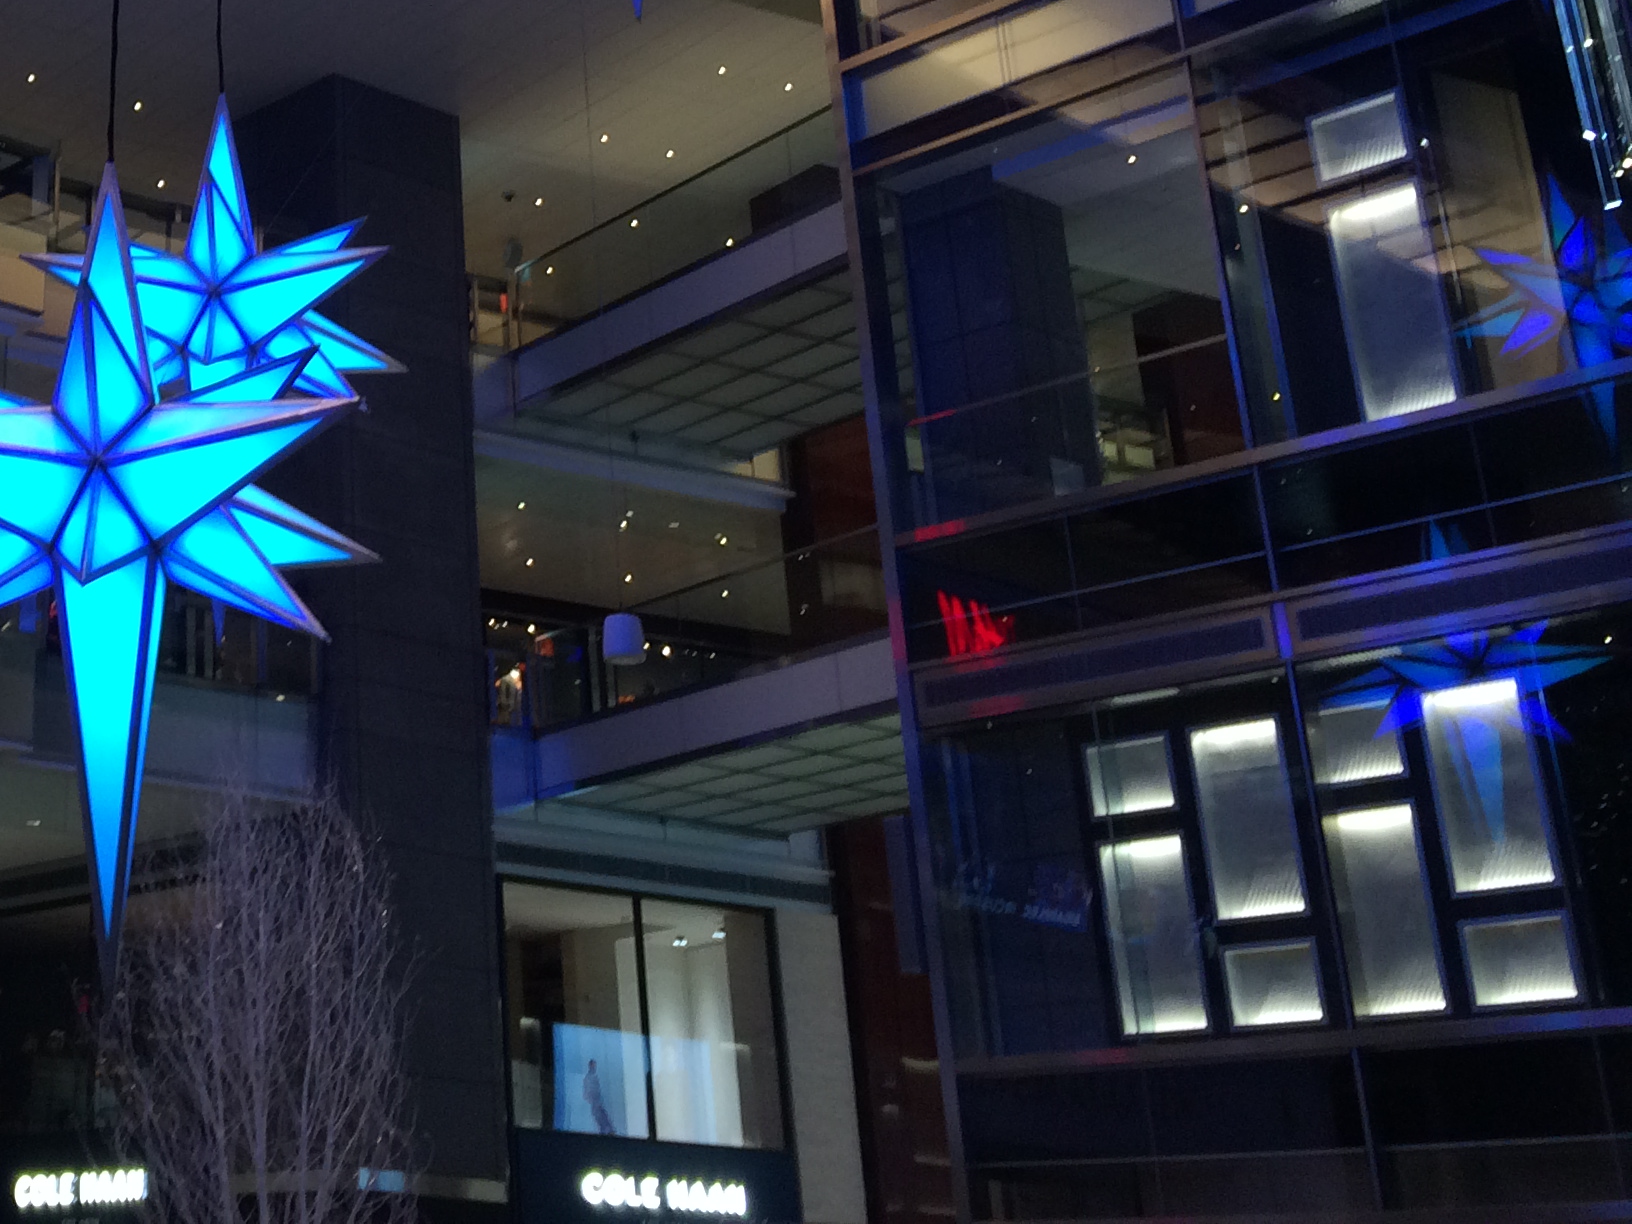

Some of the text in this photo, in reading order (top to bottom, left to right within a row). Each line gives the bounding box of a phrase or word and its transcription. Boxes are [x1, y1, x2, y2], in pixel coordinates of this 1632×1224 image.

[14, 1172, 77, 1208] COLE
[580, 1171, 747, 1216] COLE HAAN
